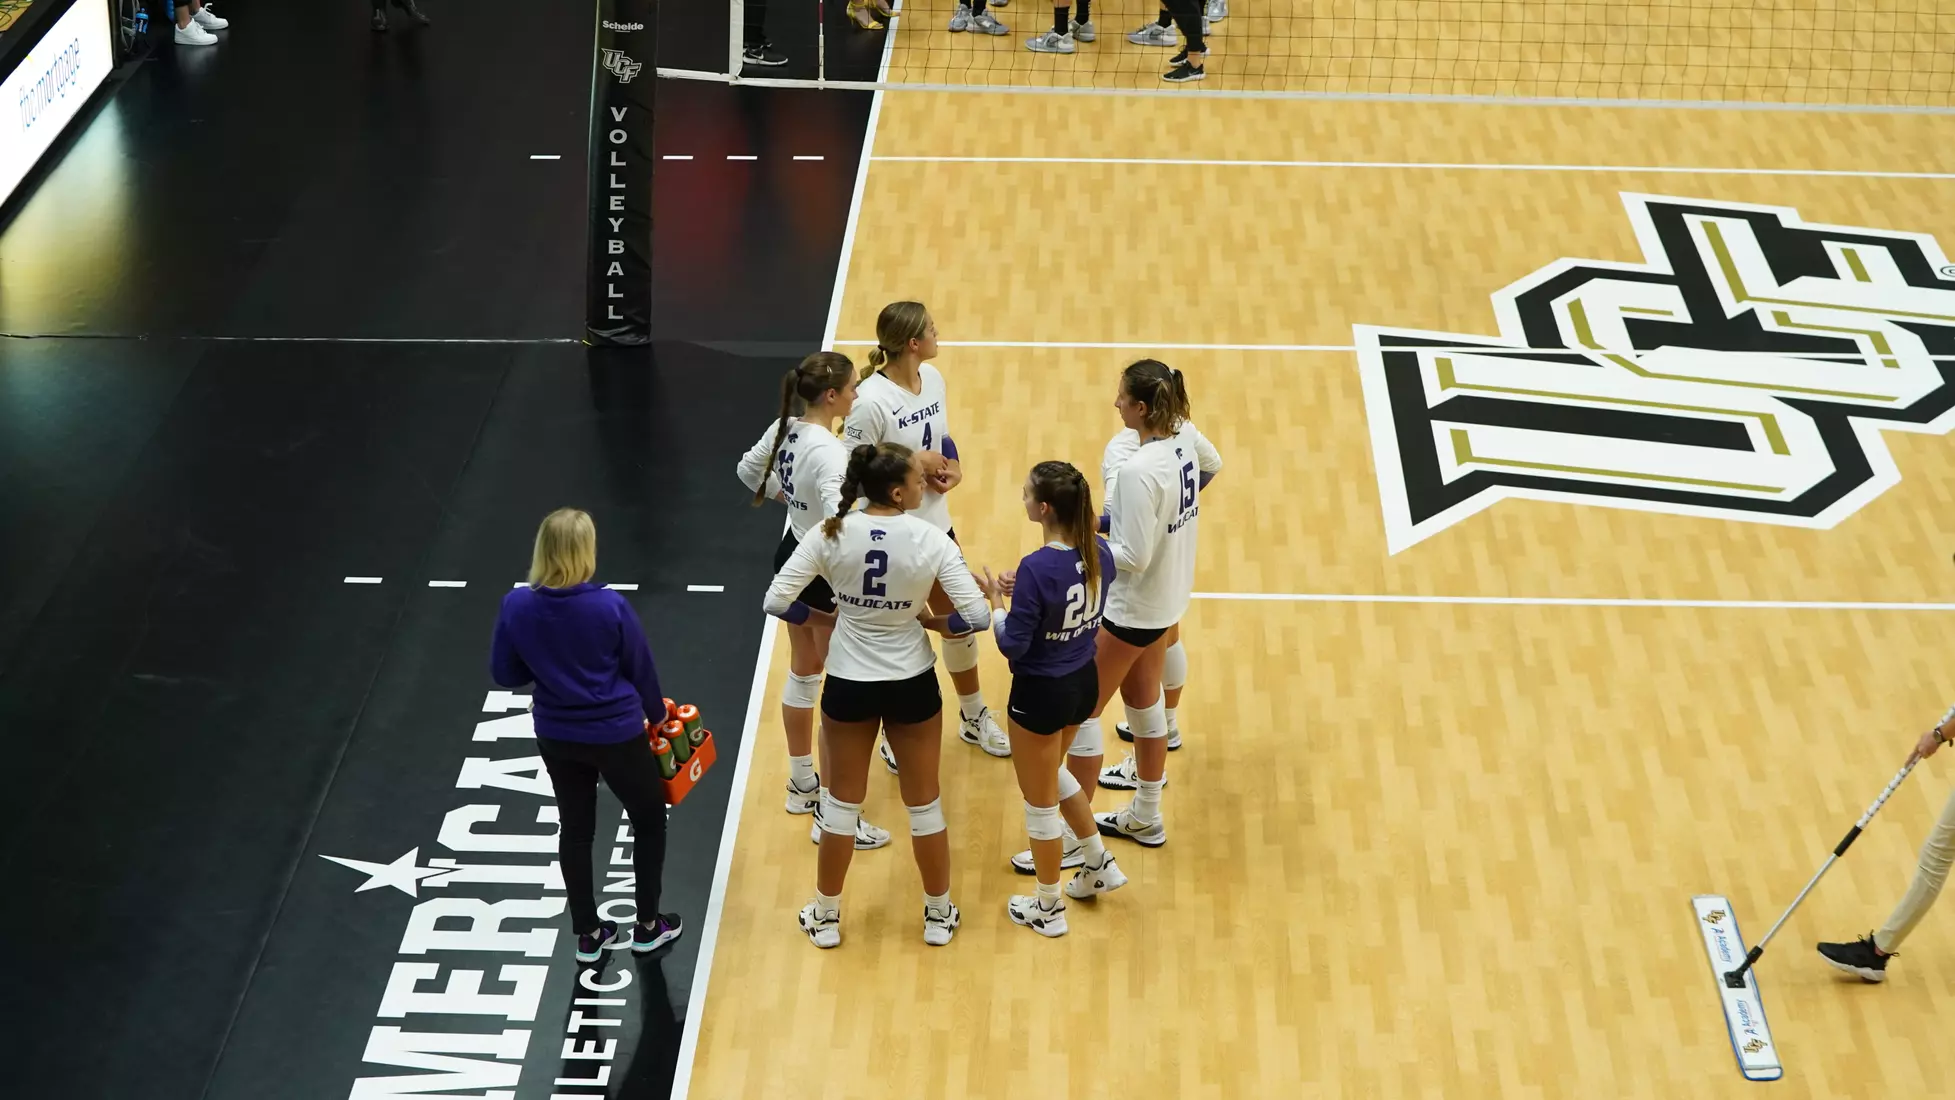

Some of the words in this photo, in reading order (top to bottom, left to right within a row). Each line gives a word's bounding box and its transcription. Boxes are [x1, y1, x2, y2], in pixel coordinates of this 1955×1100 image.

[602, 20, 644, 31] Schelde
[36, 38, 81, 115] mortgage
[600, 48, 642, 83] UCF
[606, 107, 628, 320] VOLLEYBALL
[898, 402, 940, 430] K-STATE
[922, 422, 932, 451] 4
[1179, 461, 1195, 515] 15
[862, 550, 888, 597] 2
[838, 591, 913, 610] WILDCATS
[1062, 576, 1102, 630] 20
[689, 758, 702, 782] G
[550, 968, 633, 1100] LETIC
